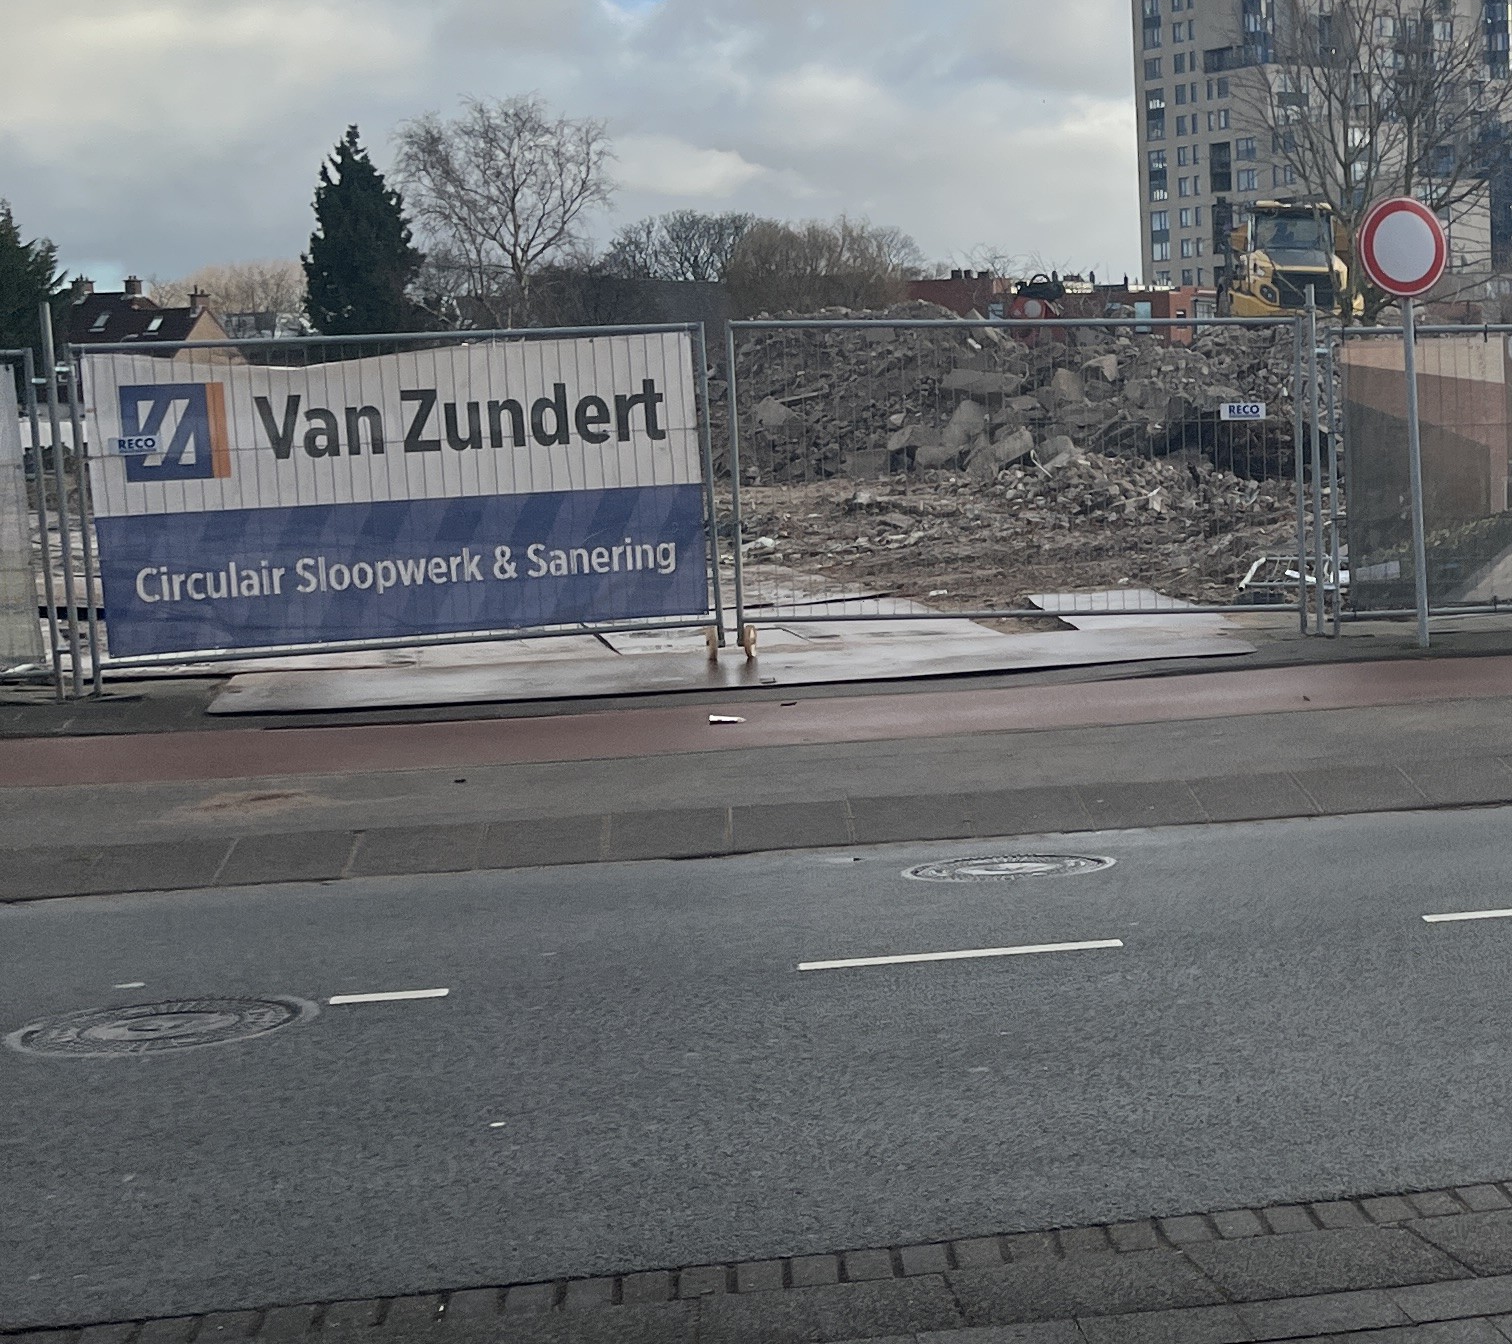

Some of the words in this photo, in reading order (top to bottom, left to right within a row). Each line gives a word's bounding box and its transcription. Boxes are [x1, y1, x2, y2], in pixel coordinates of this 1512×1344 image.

[253, 394, 385, 460] Van
[400, 378, 667, 453] Zundert
[1229, 404, 1260, 415] RECO
[118, 437, 156, 450] RECO
[135, 559, 286, 603] Circulair
[295, 547, 484, 594] Sloopwerk
[493, 544, 518, 580] &
[526, 536, 677, 579] Sanering
